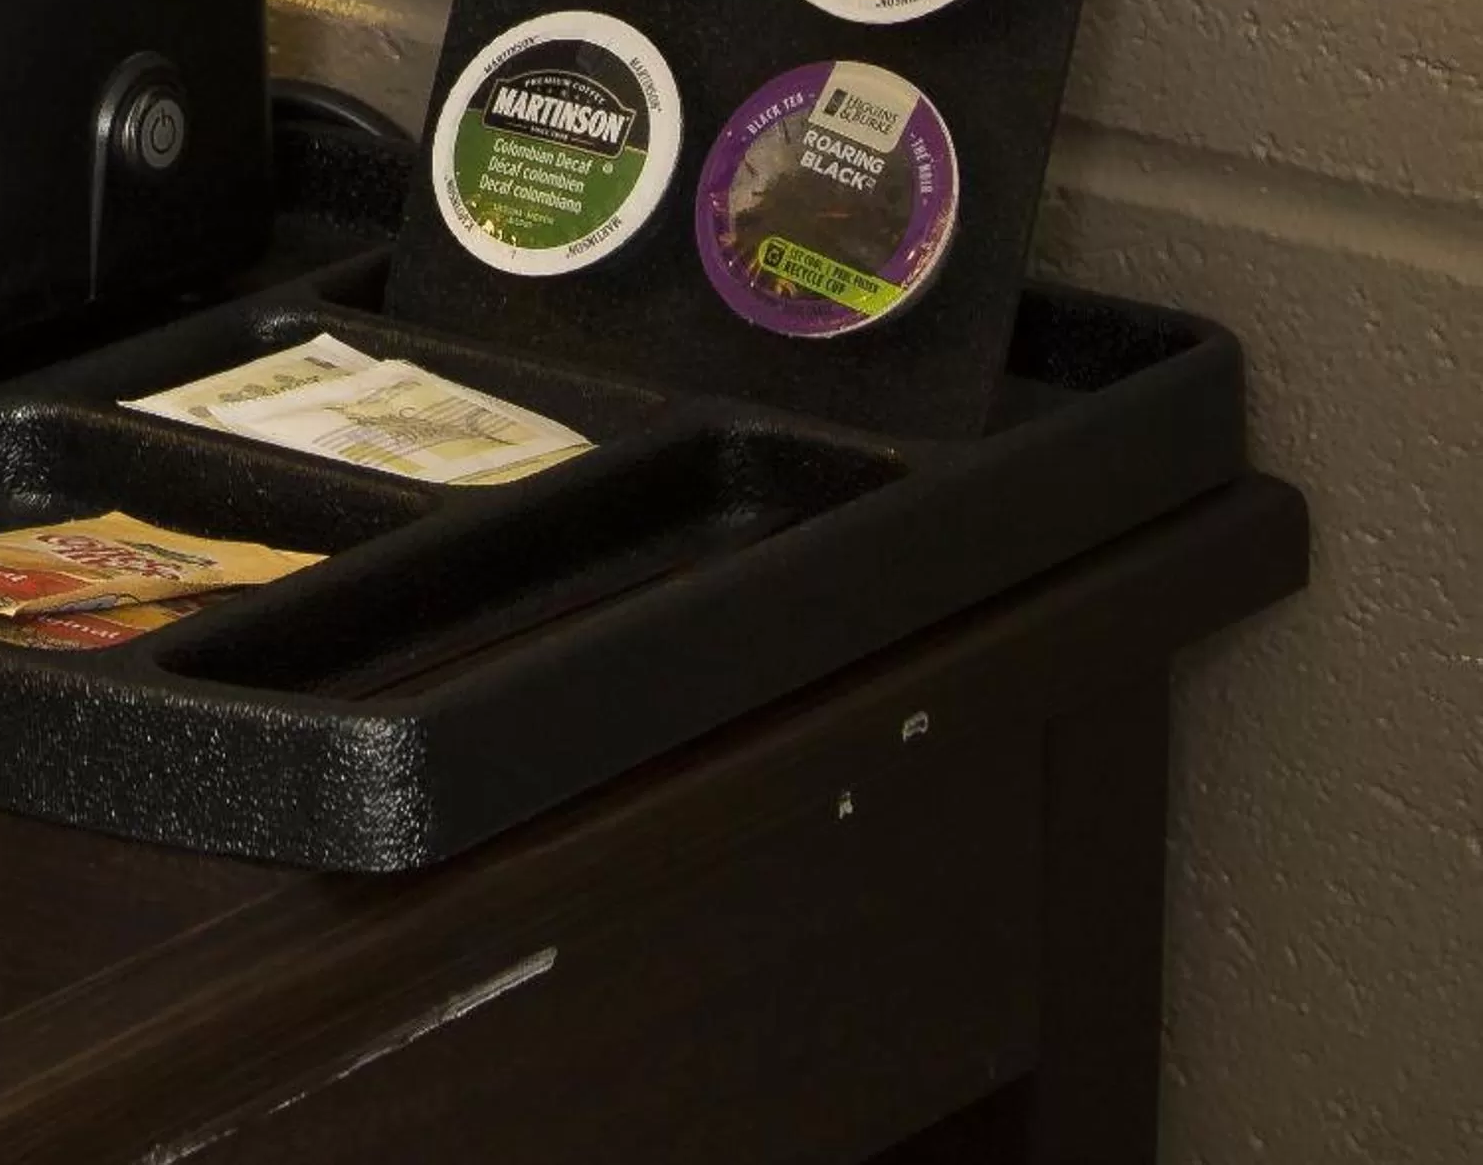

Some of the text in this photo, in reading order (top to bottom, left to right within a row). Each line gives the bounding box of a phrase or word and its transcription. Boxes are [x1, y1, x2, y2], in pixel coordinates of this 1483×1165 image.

[525, 75, 607, 105] PREMIUM COFFEE
[846, 94, 899, 123] HIGGINS
[491, 86, 625, 143] MARTINSON
[747, 104, 781, 134] BLACK
[492, 138, 593, 175] Colombian Decaf
[800, 151, 869, 192] BLACK
[803, 131, 886, 174] ROARING
[488, 155, 585, 193] Décaf colombien
[479, 174, 513, 195] Decaf
[513, 181, 583, 216] colombiano
